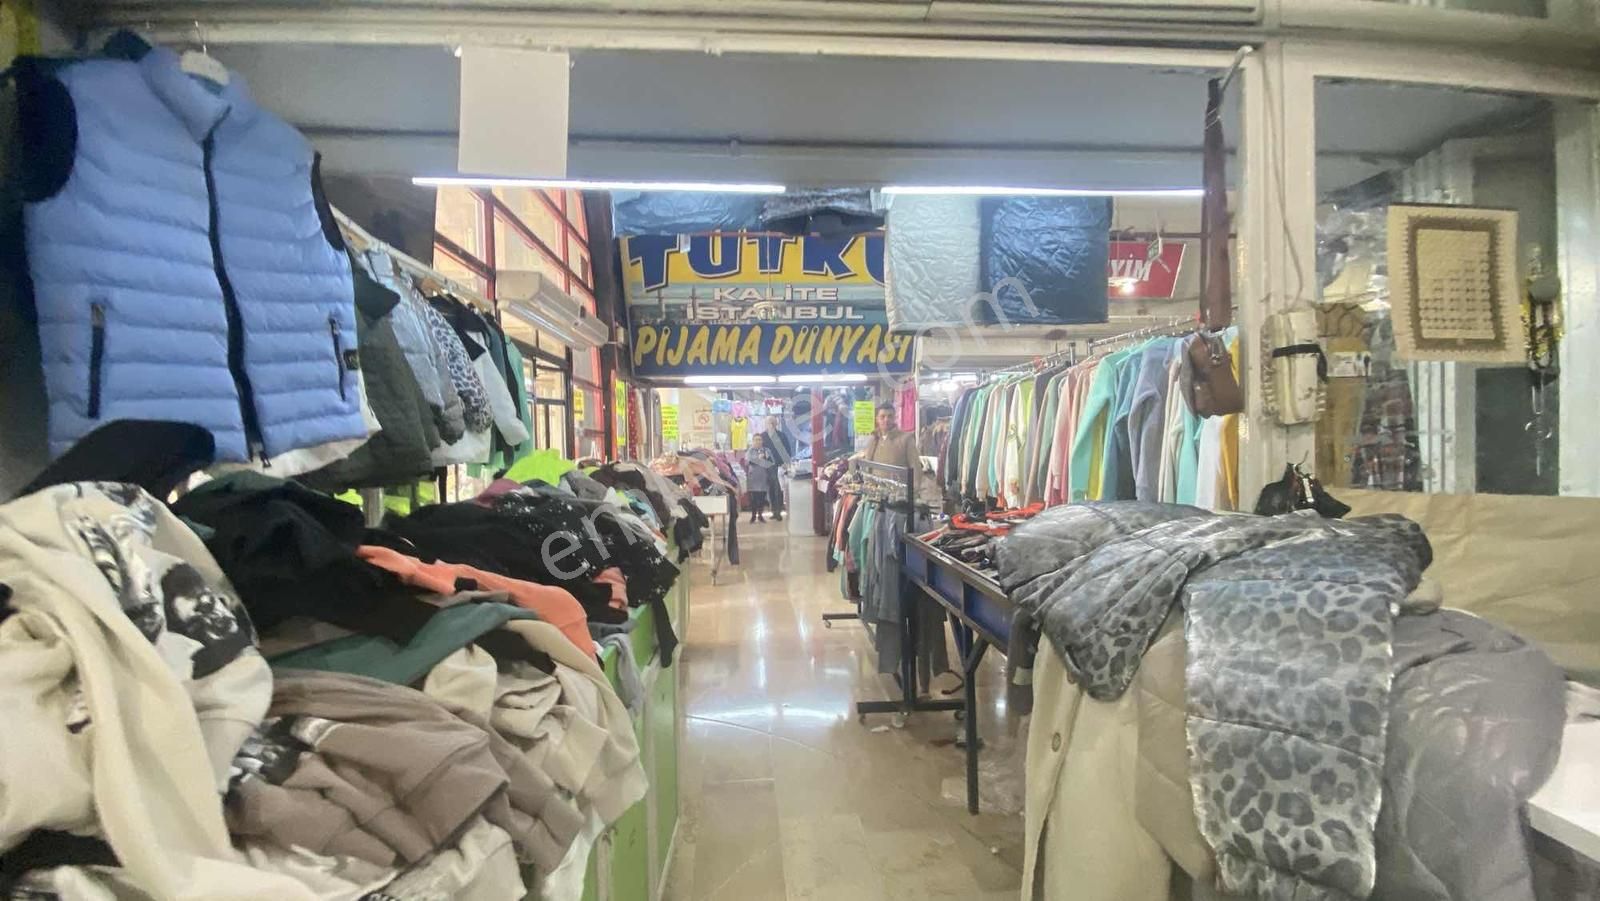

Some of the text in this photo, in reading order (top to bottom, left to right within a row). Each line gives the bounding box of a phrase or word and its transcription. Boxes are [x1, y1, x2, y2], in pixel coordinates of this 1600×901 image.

[1107, 253, 1153, 282] YİM
[713, 284, 838, 301] KALİTE
[686, 298, 864, 320] İSTANBUL
[634, 324, 912, 366] PİJAMA DÜNYASI
